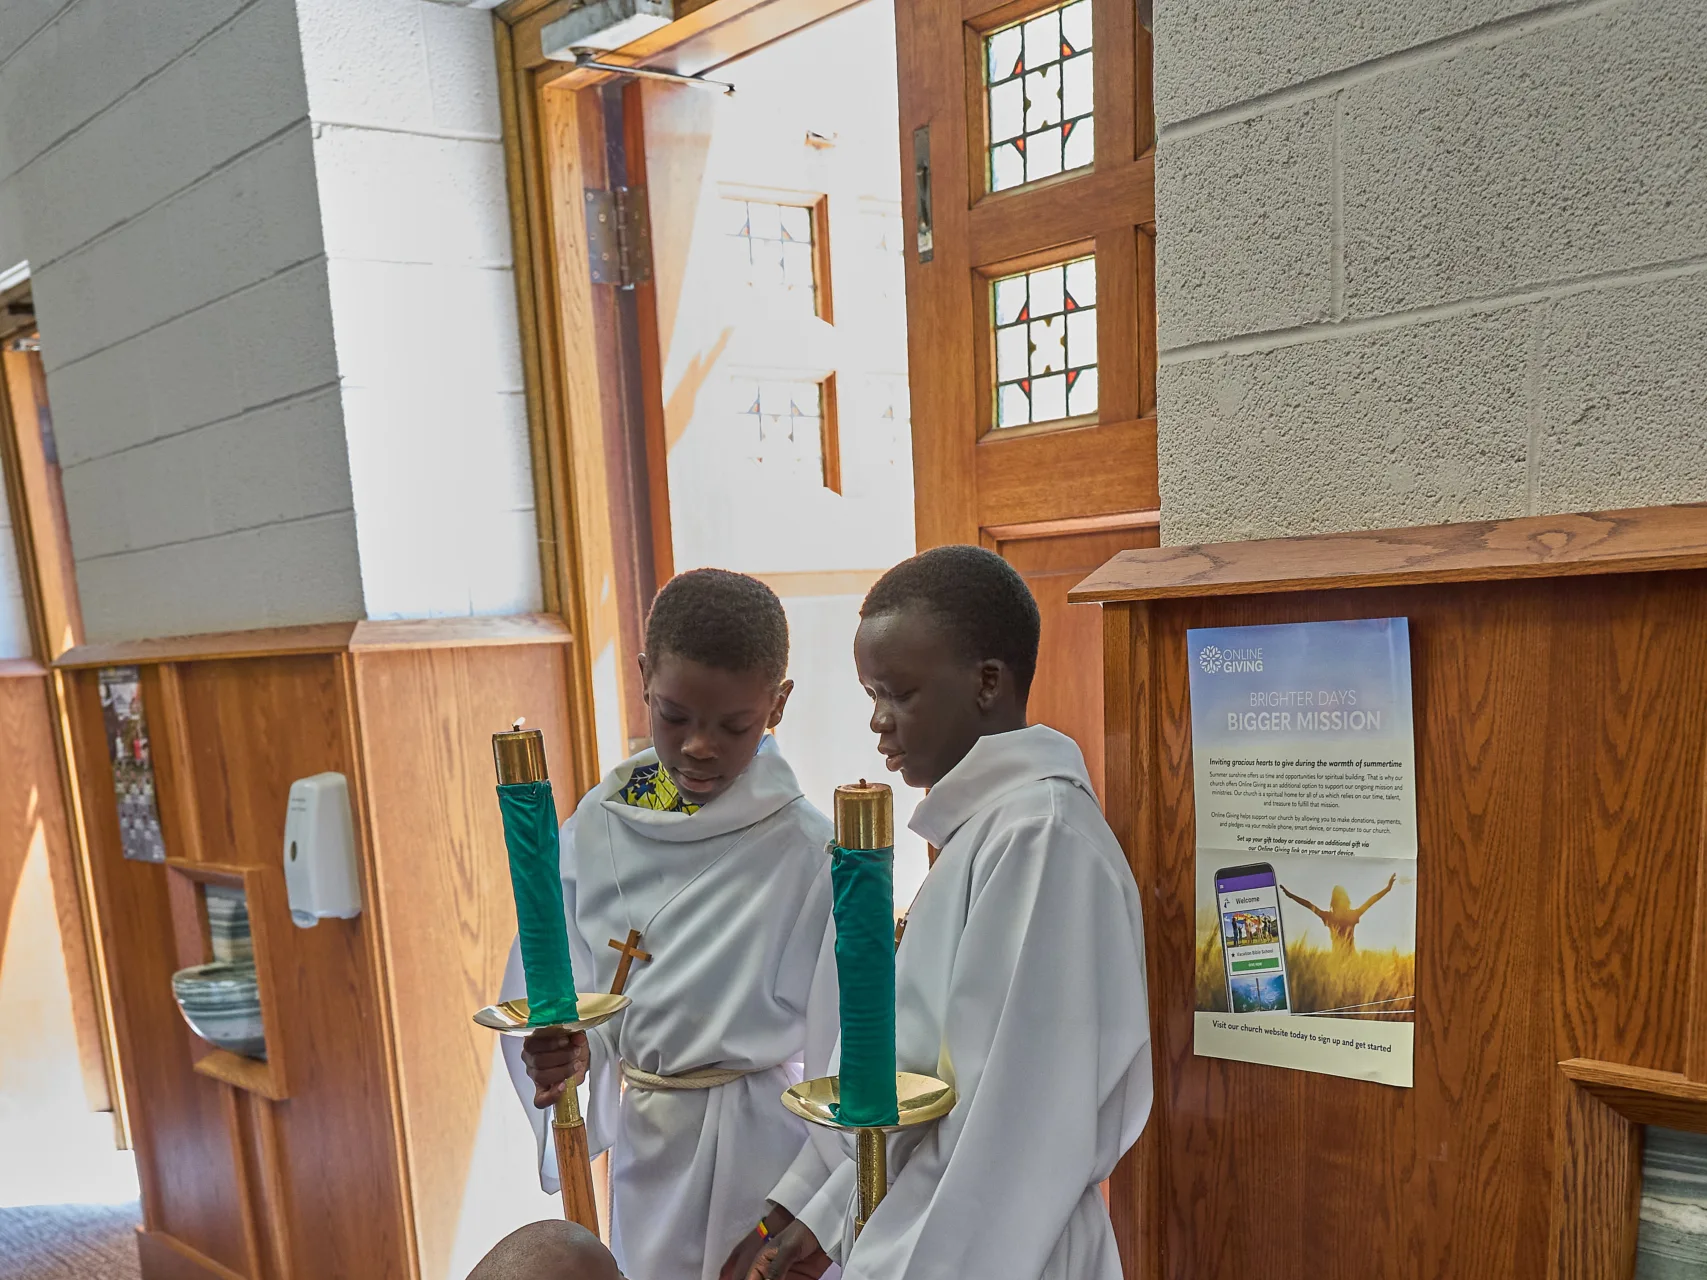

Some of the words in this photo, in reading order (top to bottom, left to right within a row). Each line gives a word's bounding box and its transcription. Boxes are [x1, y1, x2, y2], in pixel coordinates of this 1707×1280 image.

[1223, 648, 1263, 660] ONLINE
[1224, 660, 1263, 673] GIVING
[1250, 690, 1313, 706] BRIGHTER
[1318, 689, 1356, 705] DAYS
[1228, 712, 1291, 731] BIGGER
[1297, 710, 1381, 730] MISSION
[1210, 758, 1230, 767] Inviting
[1232, 758, 1254, 767] gracious
[1282, 759, 1293, 768] give
[1295, 759, 1315, 768] during
[1355, 759, 1362, 768] of
[1253, 781, 1266, 789] Giving
[1333, 826, 1355, 834] computer
[1273, 837, 1287, 845] today
[1352, 840, 1360, 848] gift
[1275, 846, 1290, 854] Giving
[1236, 896, 1260, 904] Welcome
[1213, 1020, 1226, 1029] Visit
[1241, 1024, 1262, 1033] church
[1264, 1028, 1288, 1037] website
[1290, 1031, 1307, 1041] today
[1318, 1034, 1330, 1044] sign
[1333, 1038, 1340, 1046] up
[1367, 1044, 1391, 1052] started
